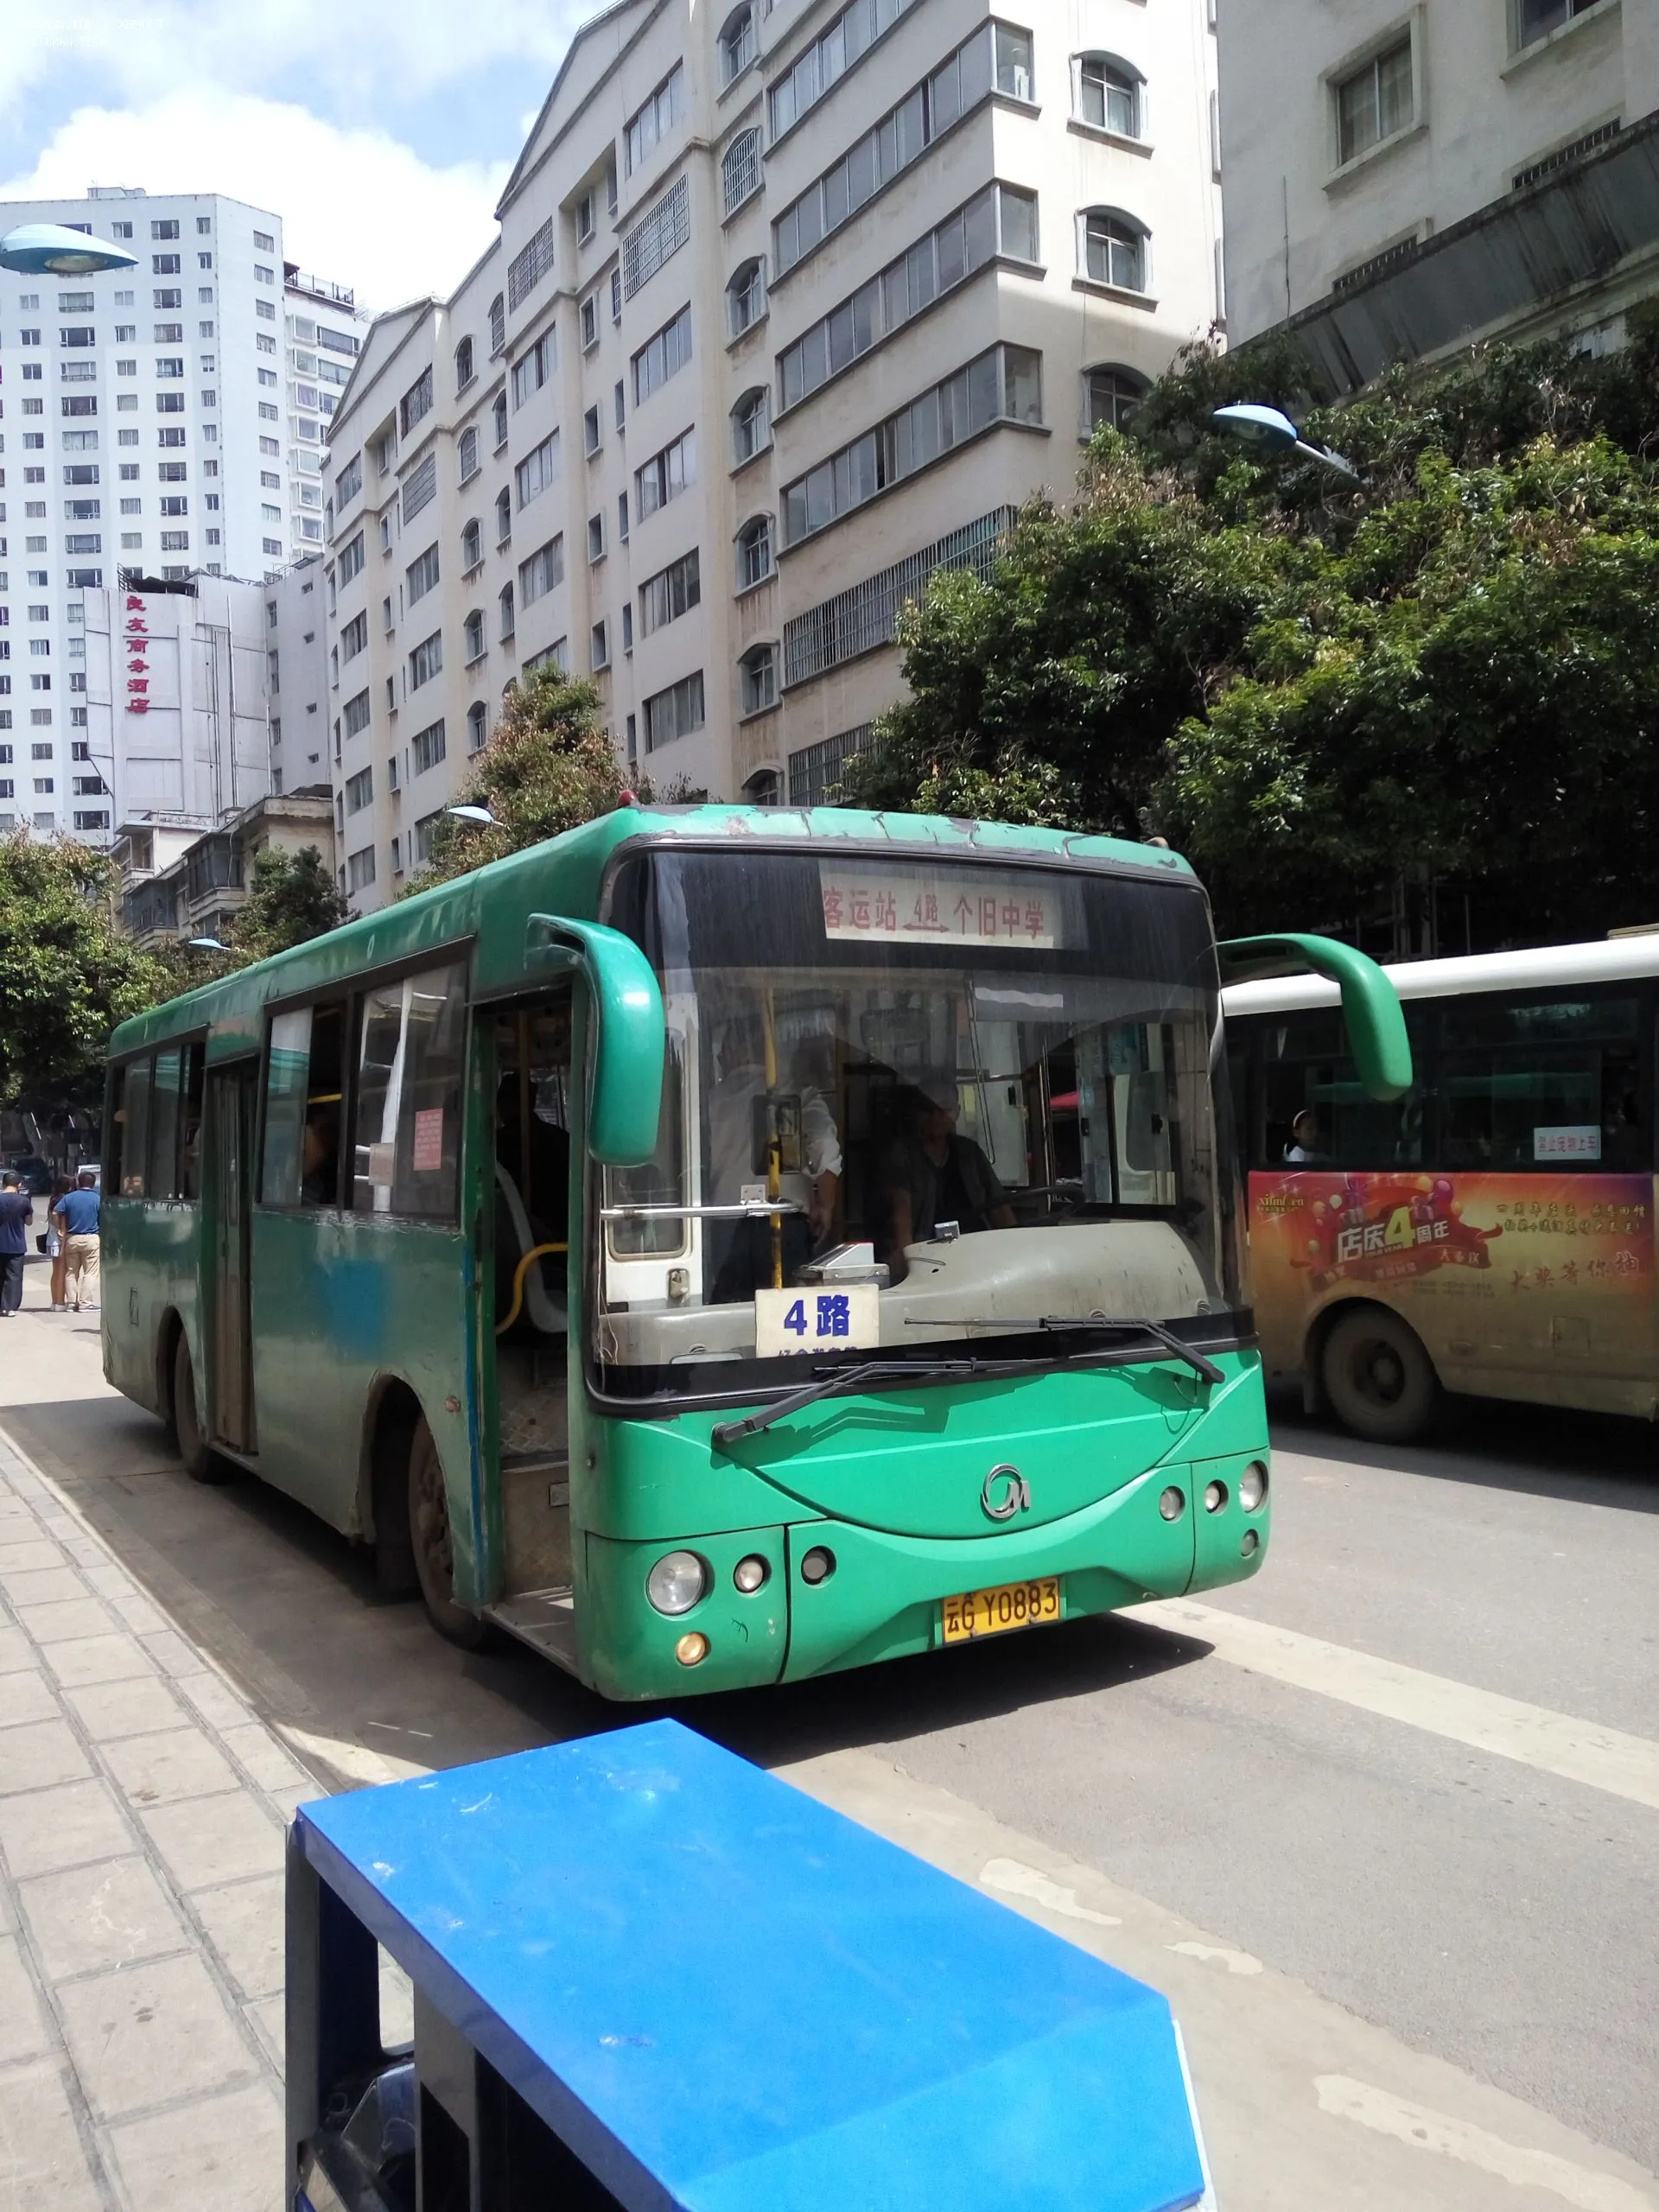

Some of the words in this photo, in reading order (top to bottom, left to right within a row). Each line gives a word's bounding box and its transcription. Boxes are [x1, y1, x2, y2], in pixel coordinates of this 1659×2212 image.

[126, 594, 150, 715] 良友商务酒店
[823, 886, 897, 931] 客运站
[913, 892, 938, 923] 4路
[953, 893, 1045, 940] 个旧中学
[784, 1294, 851, 1337] 4路
